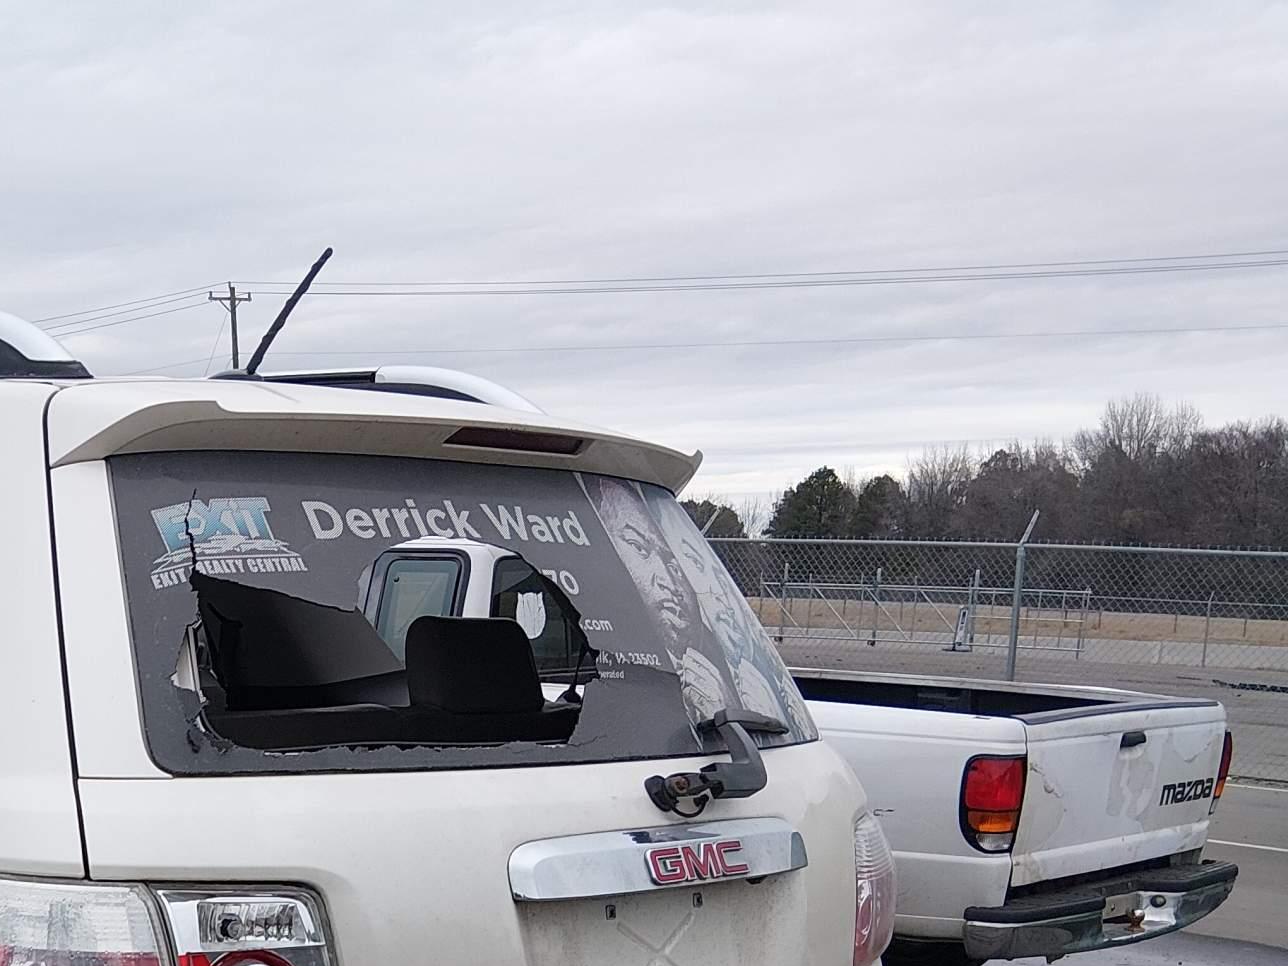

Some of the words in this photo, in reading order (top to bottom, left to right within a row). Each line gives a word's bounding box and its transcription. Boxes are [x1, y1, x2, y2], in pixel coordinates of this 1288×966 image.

[151, 497, 271, 550] EXIT
[301, 498, 481, 540] Derrick
[479, 502, 591, 547] Ward
[151, 567, 187, 589] EXIT
[247, 556, 309, 574] CENTRAL
[579, 618, 614, 631] .com
[1159, 777, 1214, 806] mazda
[645, 840, 750, 886] GMC
